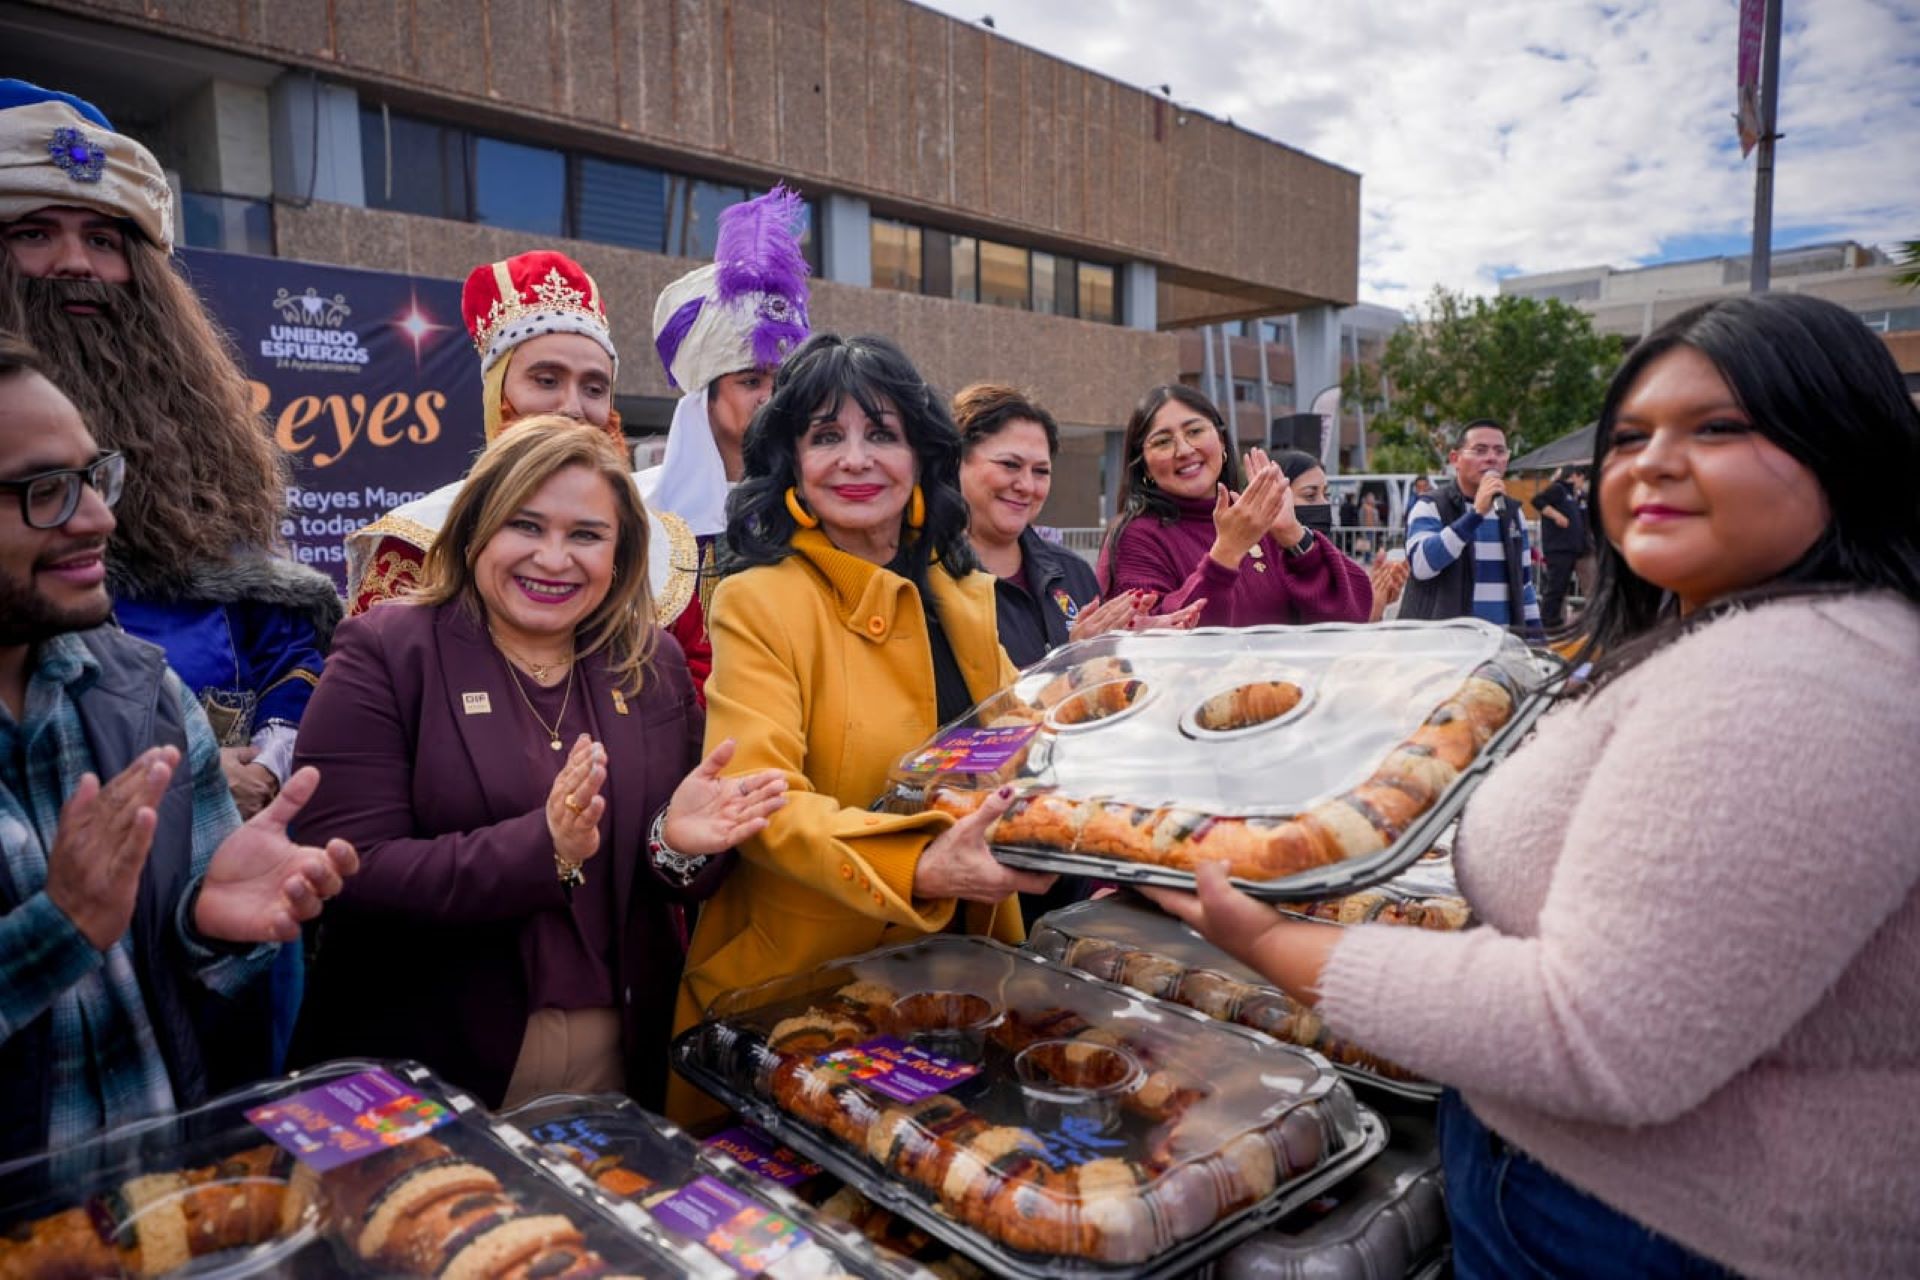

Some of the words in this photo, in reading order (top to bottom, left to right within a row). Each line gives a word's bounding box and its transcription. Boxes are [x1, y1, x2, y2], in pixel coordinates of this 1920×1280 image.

[270, 325, 358, 347] UNIENDO
[260, 340, 369, 364] ESFUERZOS
[285, 487, 360, 513] Reyes
